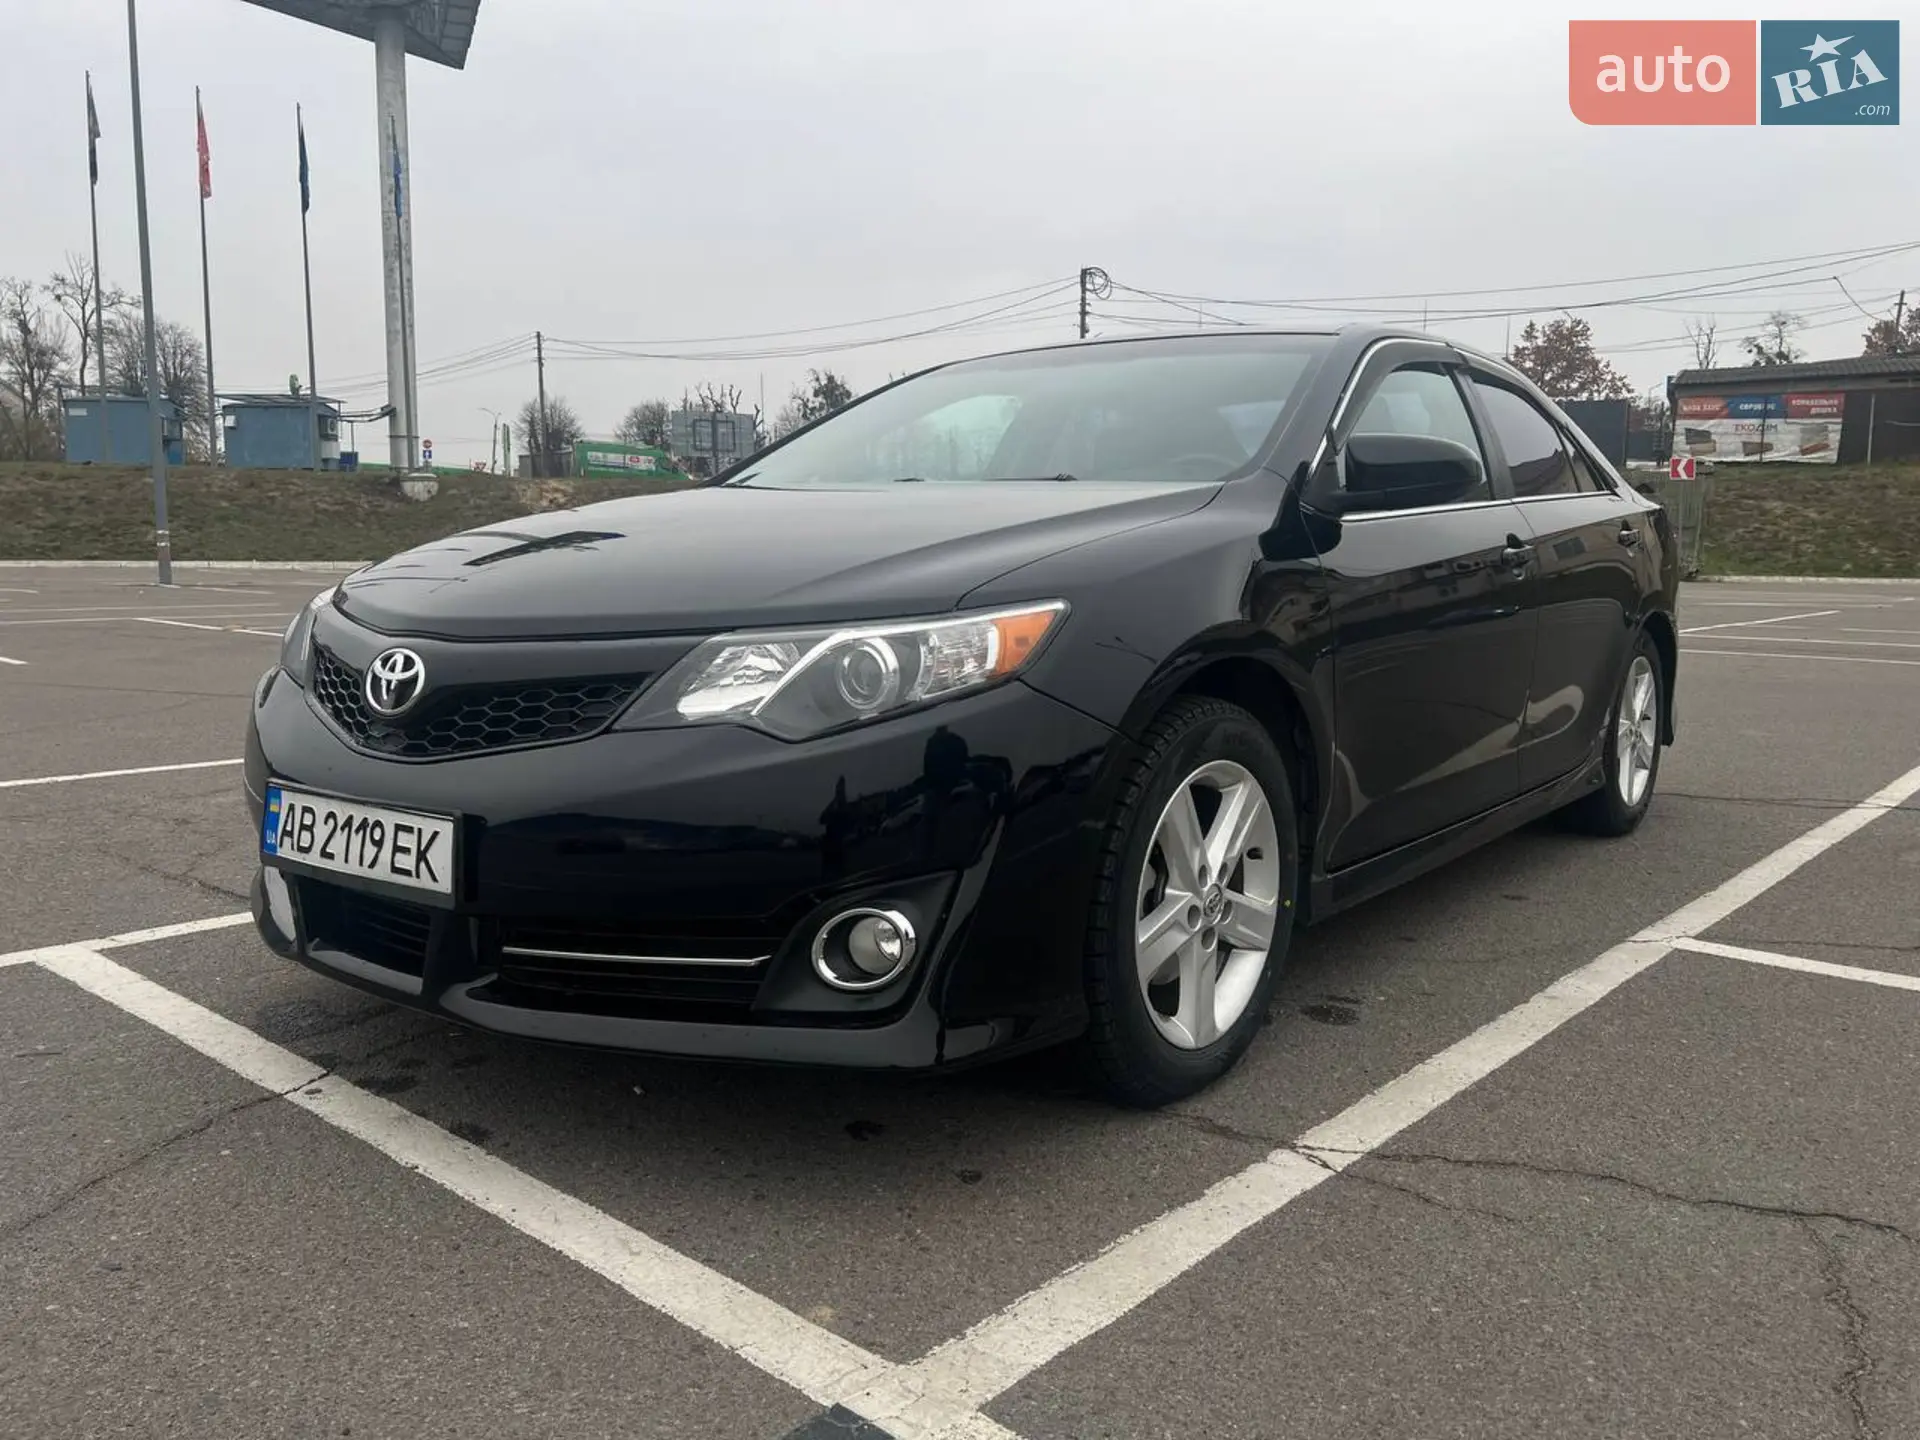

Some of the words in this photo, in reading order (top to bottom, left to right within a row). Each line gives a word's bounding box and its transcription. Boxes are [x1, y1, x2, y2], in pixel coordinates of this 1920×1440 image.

[266, 830, 277, 845] UA
[279, 803, 316, 854] AB
[319, 810, 386, 870] 2119
[390, 822, 440, 884] EK
